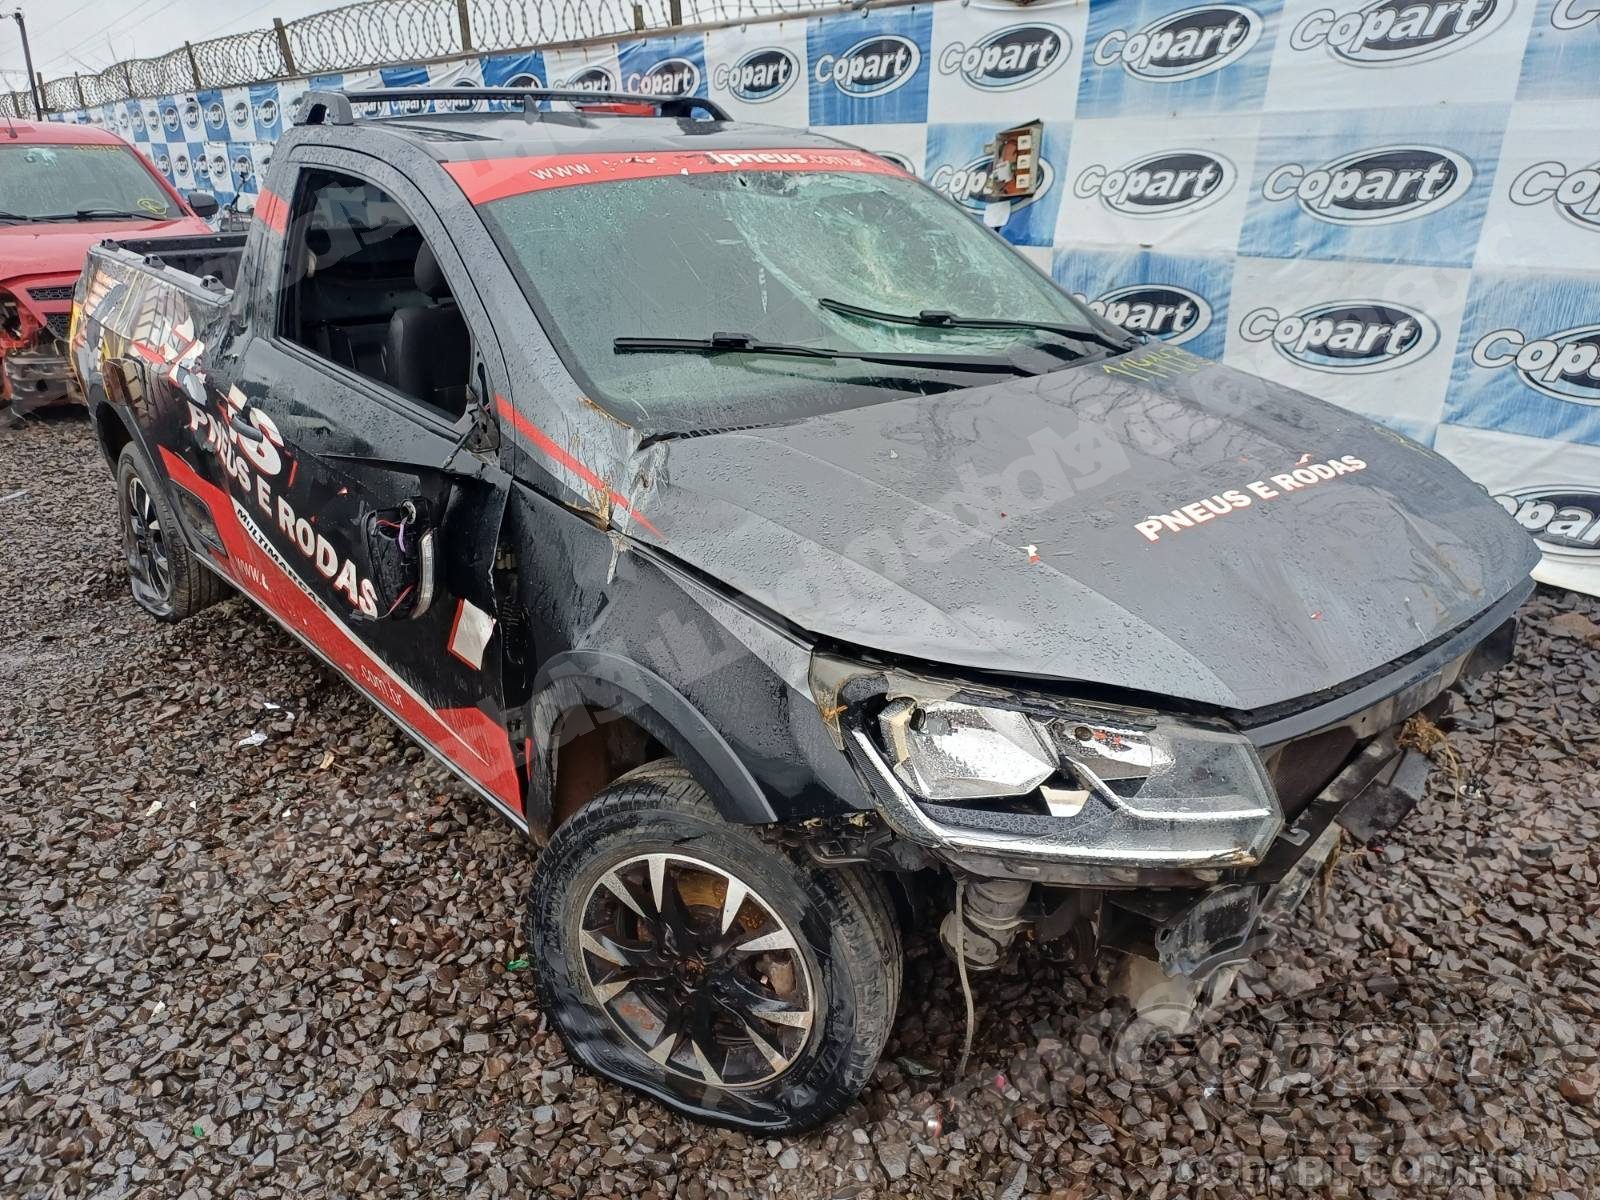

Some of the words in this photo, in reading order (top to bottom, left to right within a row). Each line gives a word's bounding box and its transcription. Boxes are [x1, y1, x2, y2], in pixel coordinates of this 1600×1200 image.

[1093, 15, 1245, 69] Copart
[1290, 0, 1486, 53] Copart
[627, 66, 692, 97] Copart
[713, 55, 787, 92] Copart
[814, 43, 907, 88] Copart
[938, 36, 1054, 80] Copart
[1074, 162, 1217, 205] Copart
[1263, 159, 1448, 208] Copart
[1239, 306, 1415, 355] Copart
[187, 401, 252, 492] PNEUS
[256, 474, 273, 519] E
[277, 494, 379, 622] RODAS
[1134, 490, 1252, 543] PNEUS
[1246, 480, 1279, 501] E
